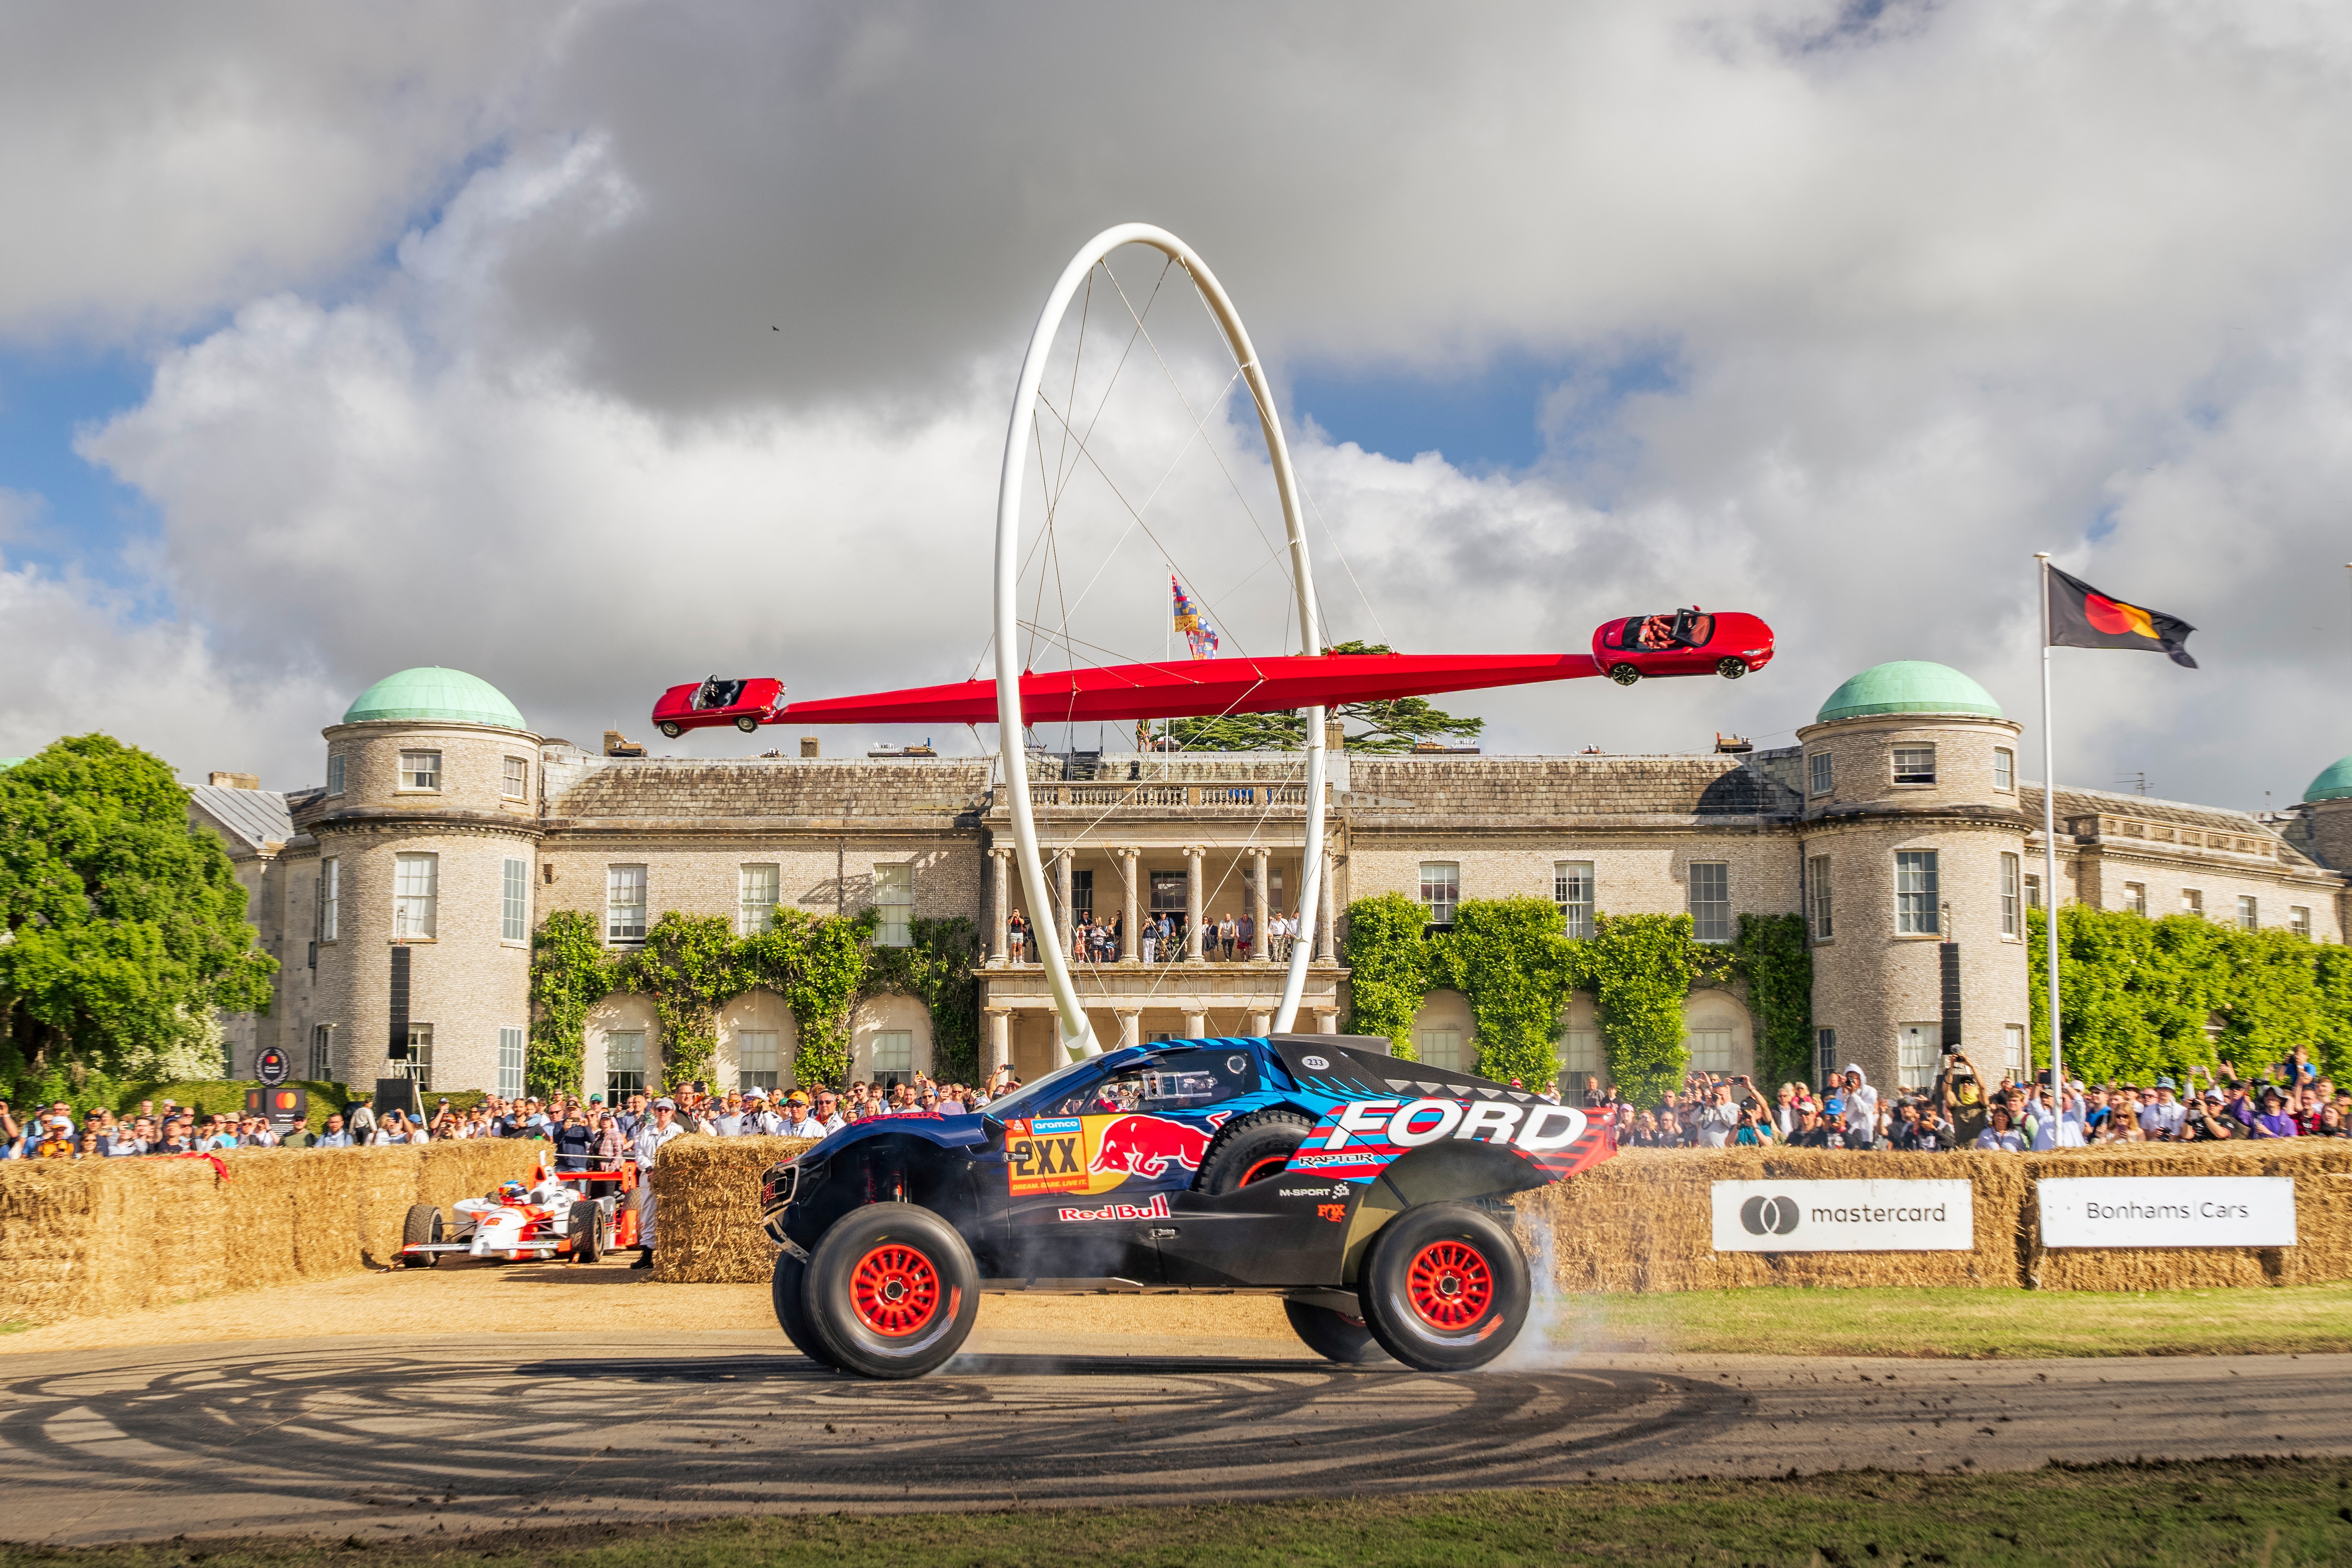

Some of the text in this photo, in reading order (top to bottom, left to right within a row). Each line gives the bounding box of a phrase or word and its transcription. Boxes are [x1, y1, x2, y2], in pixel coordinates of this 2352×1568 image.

[852, 1112, 945, 1126] RAPTOR
[1324, 1099, 1588, 1150] FORD
[1015, 1138, 1079, 1176] 2XX
[1299, 1153, 1378, 1169] RAPTOR
[1059, 1193, 1171, 1221] Red Bull
[1318, 1204, 1345, 1223] FOX
[1812, 1203, 1945, 1222] mastercard
[2087, 1201, 2249, 1218] Bonhams Cars
